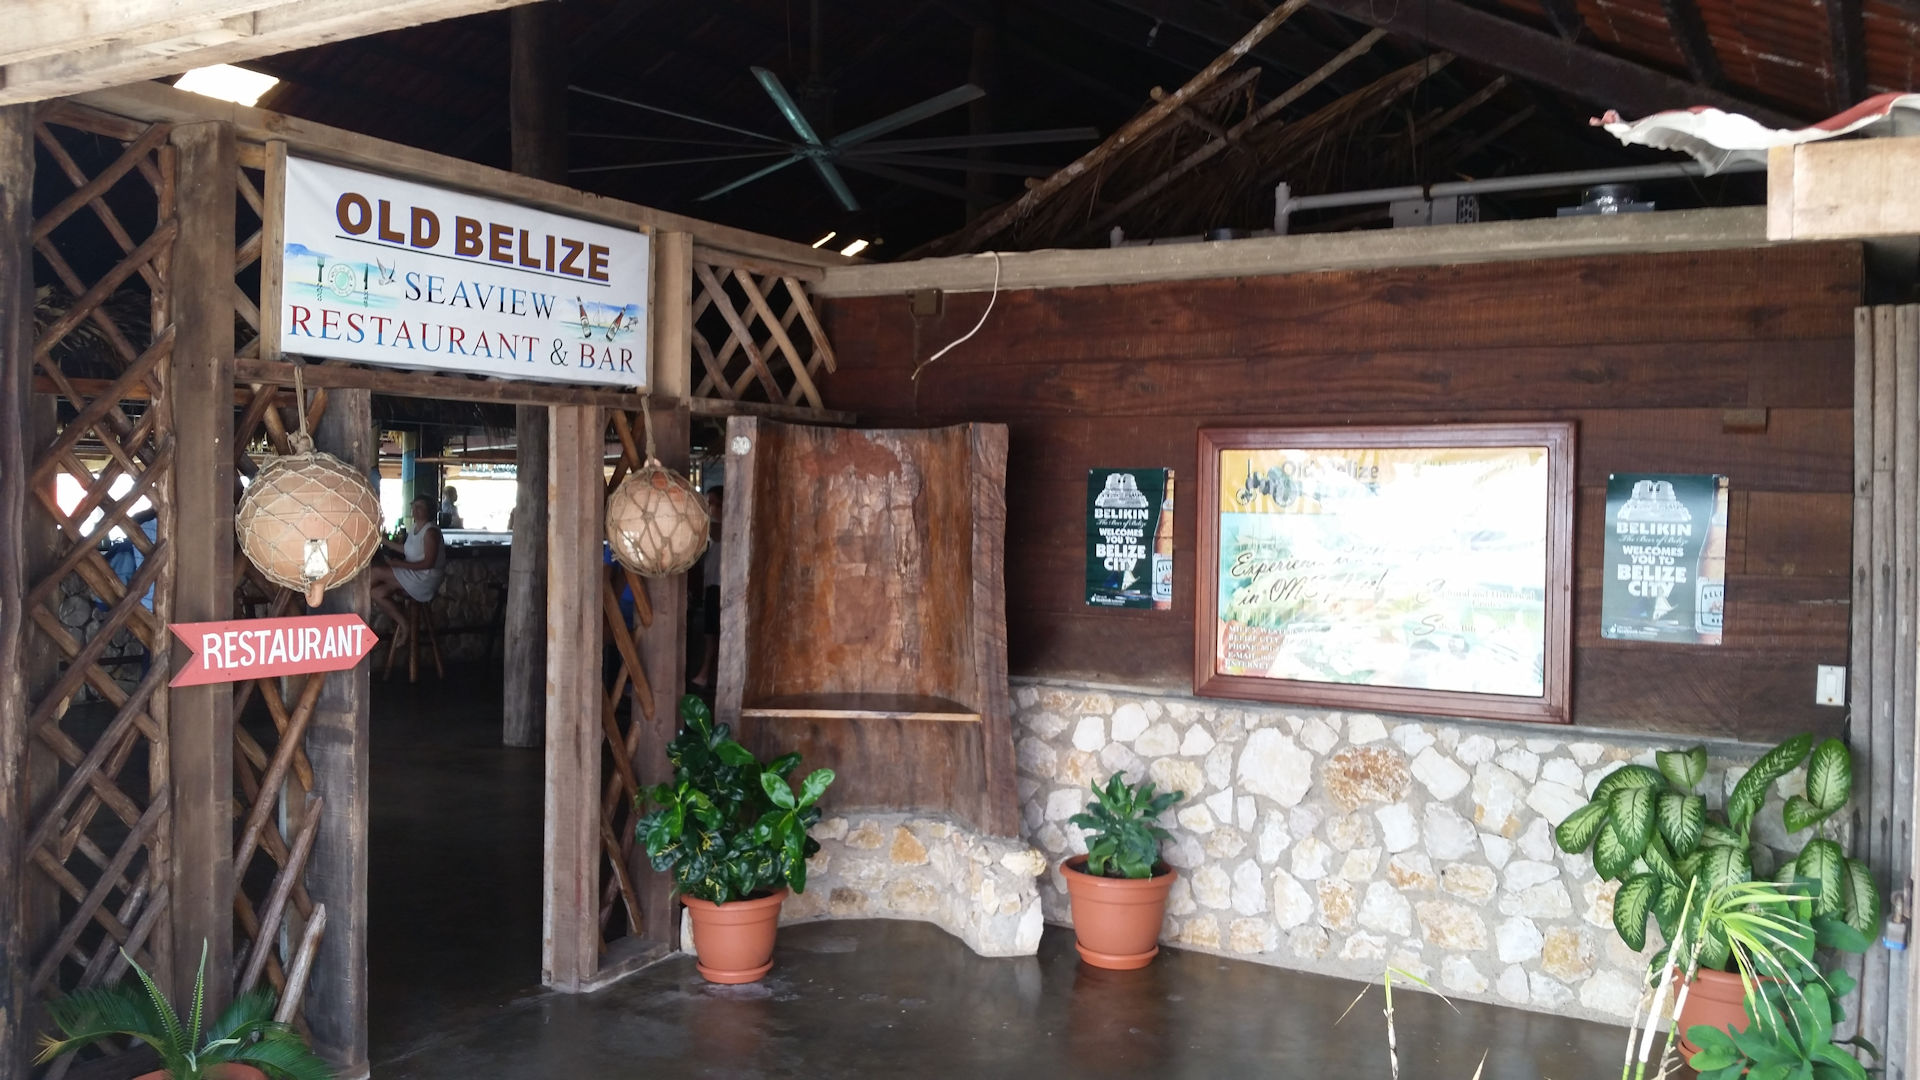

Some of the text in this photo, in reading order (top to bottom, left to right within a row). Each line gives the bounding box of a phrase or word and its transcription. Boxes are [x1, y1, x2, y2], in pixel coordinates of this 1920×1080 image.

[336, 192, 611, 282] OLD BELIZE
[405, 271, 557, 320] SEAVIEW
[288, 304, 635, 373] RESTAURANT & BAR
[1094, 508, 1149, 520] BELIKIN
[1099, 528, 1143, 537] WELCOMES
[1616, 522, 1692, 536] BELIKIN
[1106, 536, 1137, 545] YOU TO
[1095, 544, 1146, 559] BELIZE
[1622, 545, 1684, 557] WELCOMES
[1104, 558, 1138, 572] CITY
[1631, 555, 1674, 566] YOU TO
[1617, 564, 1687, 583] BELIZE
[1628, 581, 1675, 598] CITY
[202, 624, 367, 670] RESTAURANT
